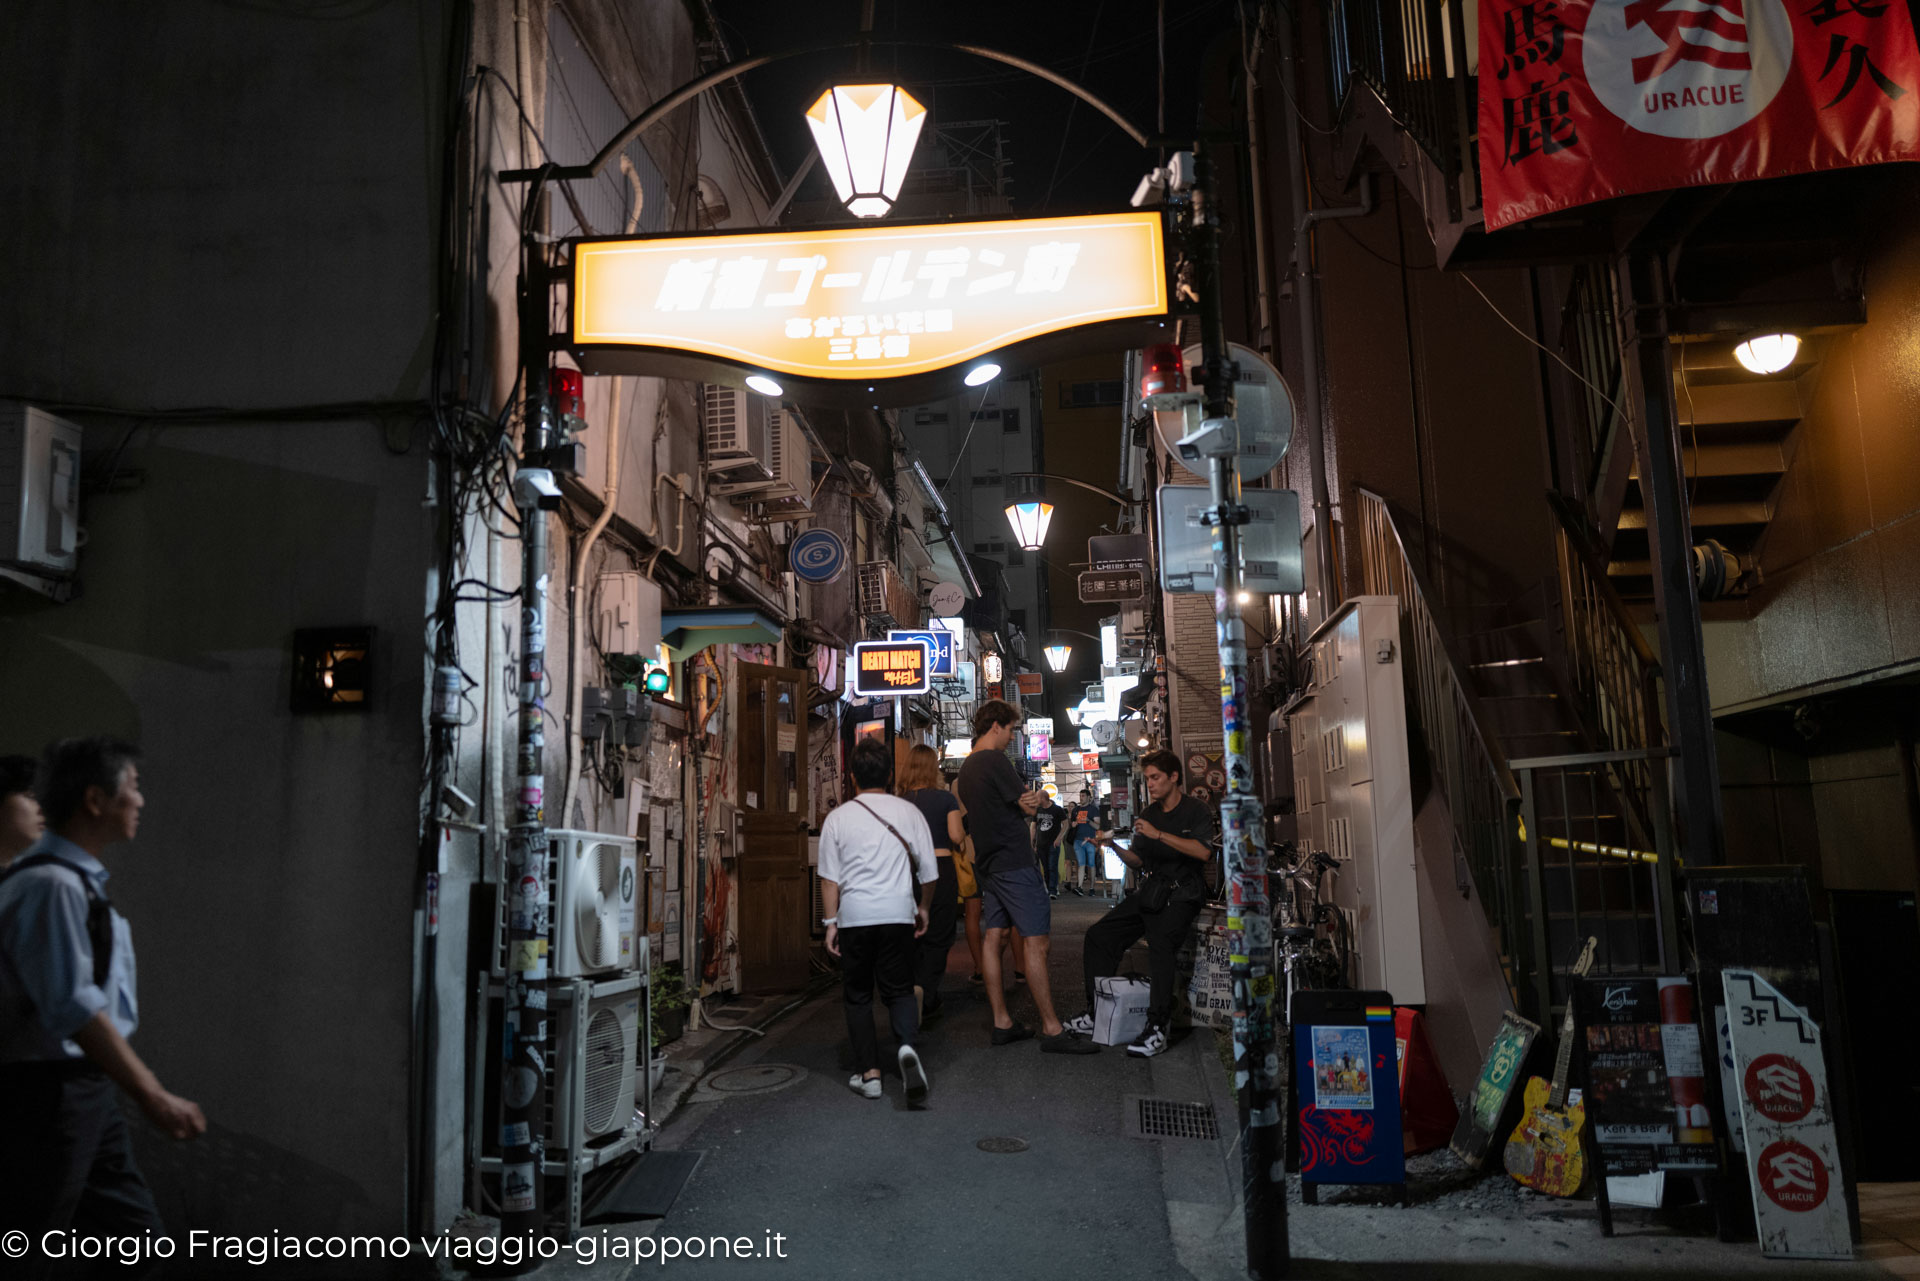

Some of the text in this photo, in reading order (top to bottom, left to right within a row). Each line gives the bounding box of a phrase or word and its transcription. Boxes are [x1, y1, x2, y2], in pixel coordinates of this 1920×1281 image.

[1497, 1, 1580, 172] 馬鹿
[1644, 83, 1745, 115] URACUE
[827, 335, 911, 361] 三番街
[1081, 578, 1142, 593] 花園三番街
[861, 649, 921, 671] DEATH MATCH
[889, 669, 922, 687] HELL
[1206, 954, 1226, 966] RUNS
[1210, 999, 1233, 1010] GRAV
[1740, 1005, 1769, 1026] 3F
[1764, 1102, 1802, 1114] URACUE
[1603, 1123, 1661, 1134] Ken's Bar
[1777, 1191, 1815, 1203] URACUE
